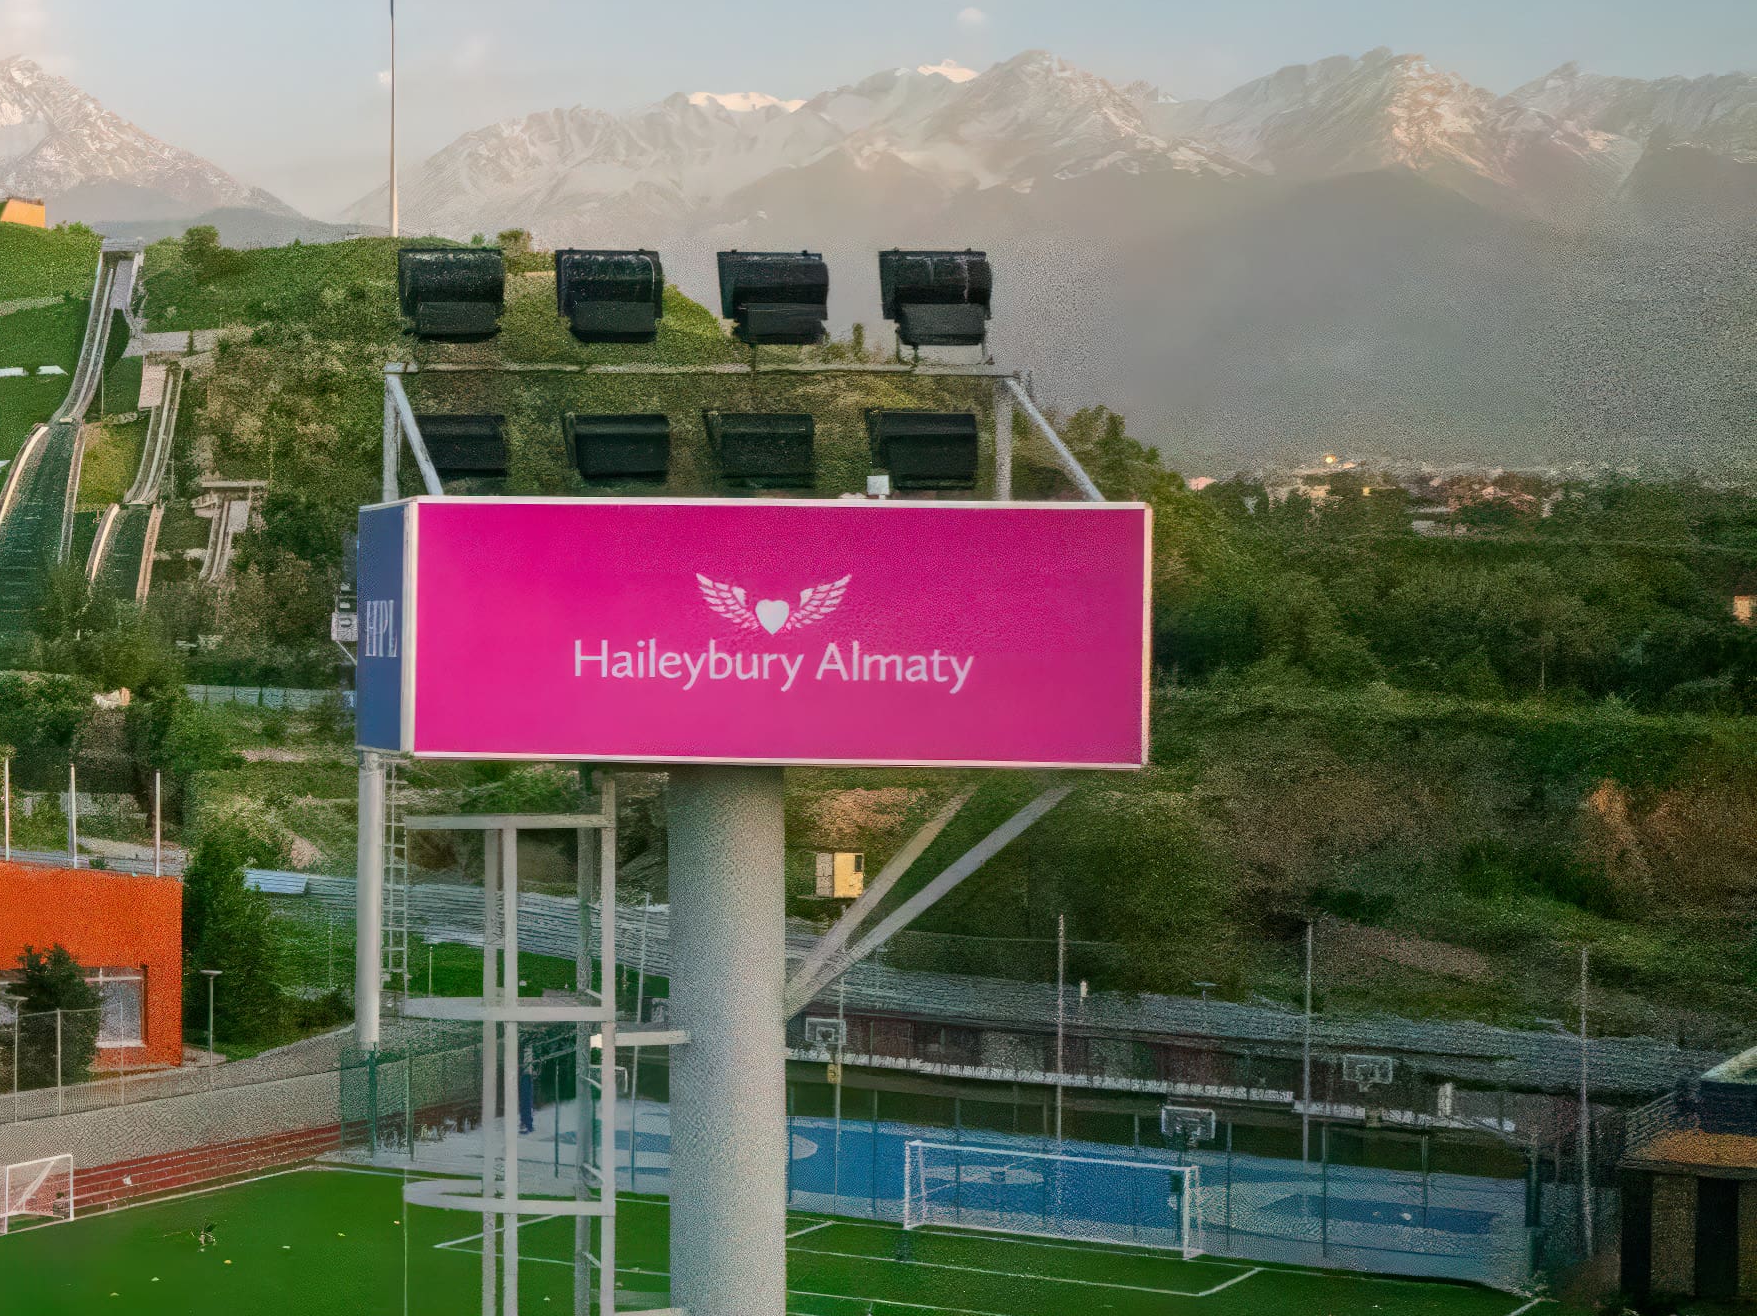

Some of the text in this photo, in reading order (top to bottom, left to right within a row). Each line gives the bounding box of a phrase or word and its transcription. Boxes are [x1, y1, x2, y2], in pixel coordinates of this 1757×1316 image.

[365, 599, 397, 658] HPL
[574, 638, 974, 694] Haileybury Almaty
